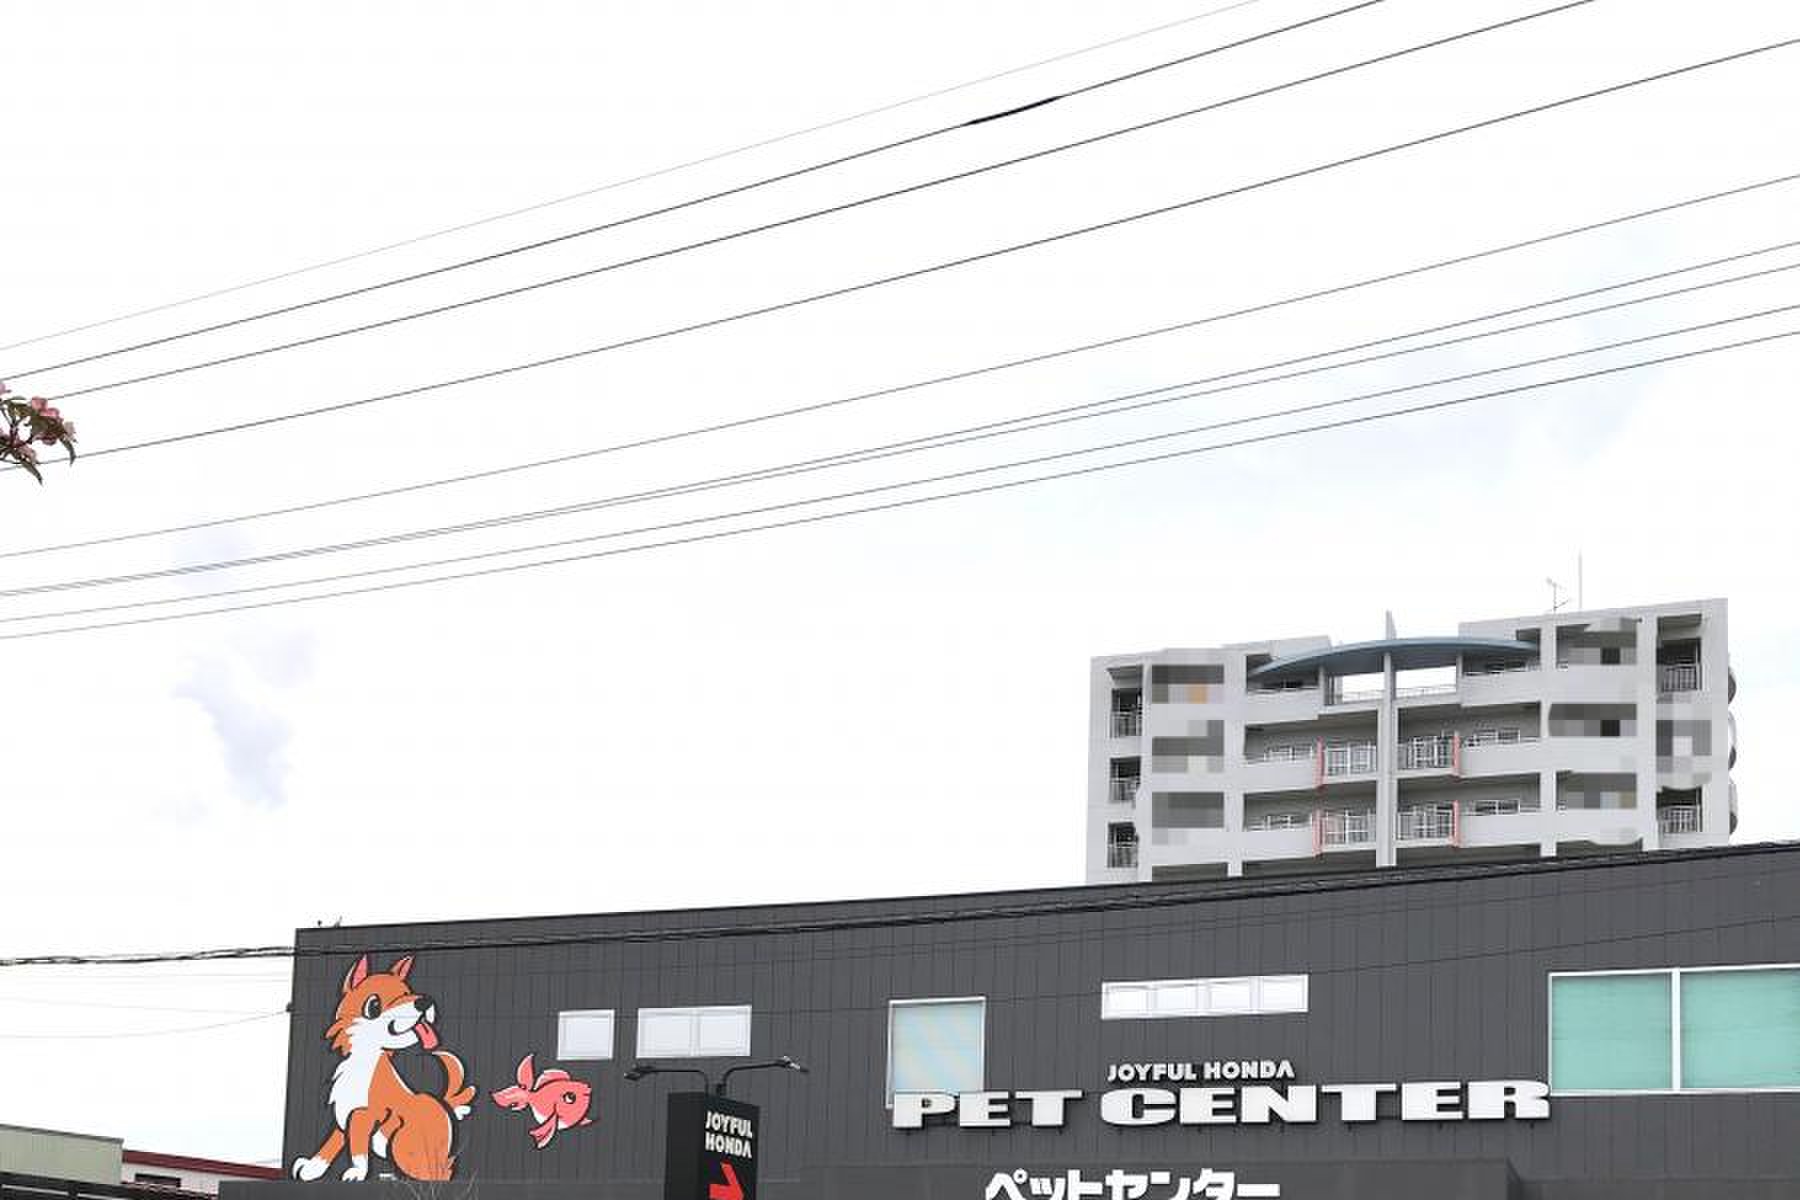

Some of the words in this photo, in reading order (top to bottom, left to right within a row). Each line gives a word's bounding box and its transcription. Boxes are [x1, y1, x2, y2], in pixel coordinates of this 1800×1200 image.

[1107, 1062, 1197, 1082] JOYFUL
[1204, 1060, 1295, 1080] HONDA
[891, 1088, 1083, 1128] PET
[1100, 1082, 1551, 1126] CENTER
[705, 1110, 753, 1138] JOYFUL
[705, 1131, 752, 1158] HONDA
